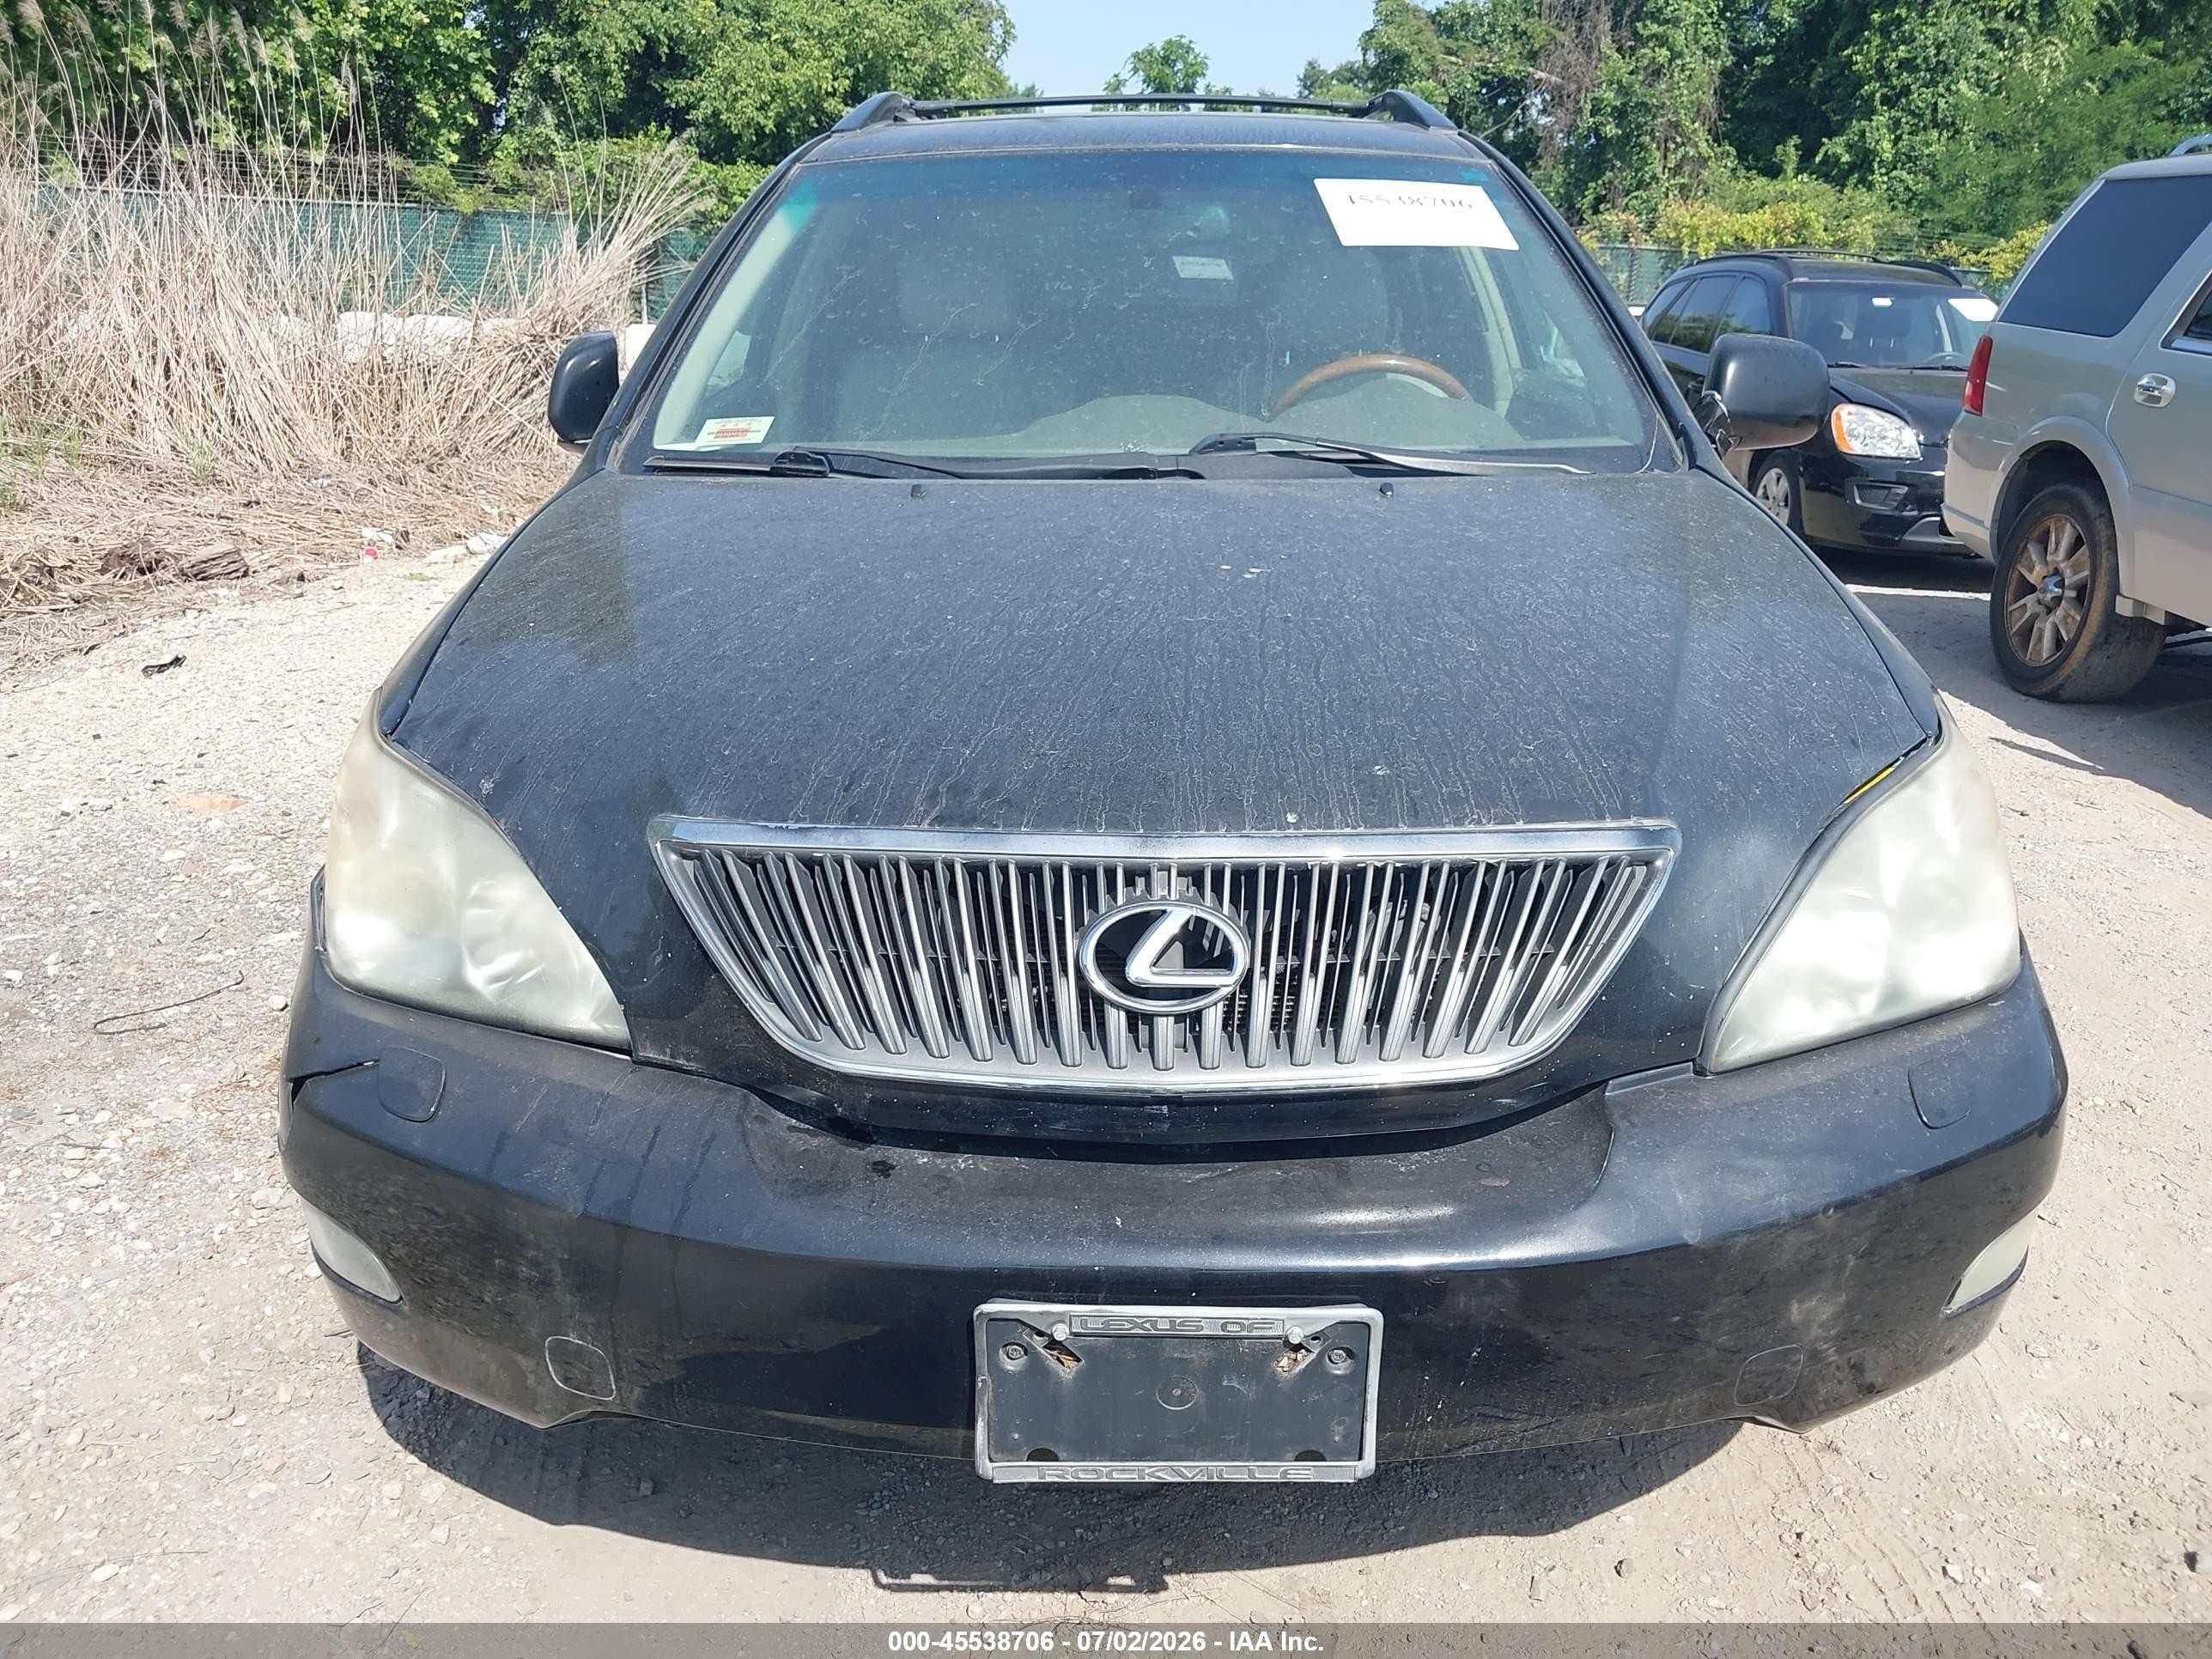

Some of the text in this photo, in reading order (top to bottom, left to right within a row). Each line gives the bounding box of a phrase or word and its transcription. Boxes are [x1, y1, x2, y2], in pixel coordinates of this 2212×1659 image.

[1080, 1317, 1275, 1334] LEXUS OF
[1037, 1466, 1315, 1480] ROCKVILLE
